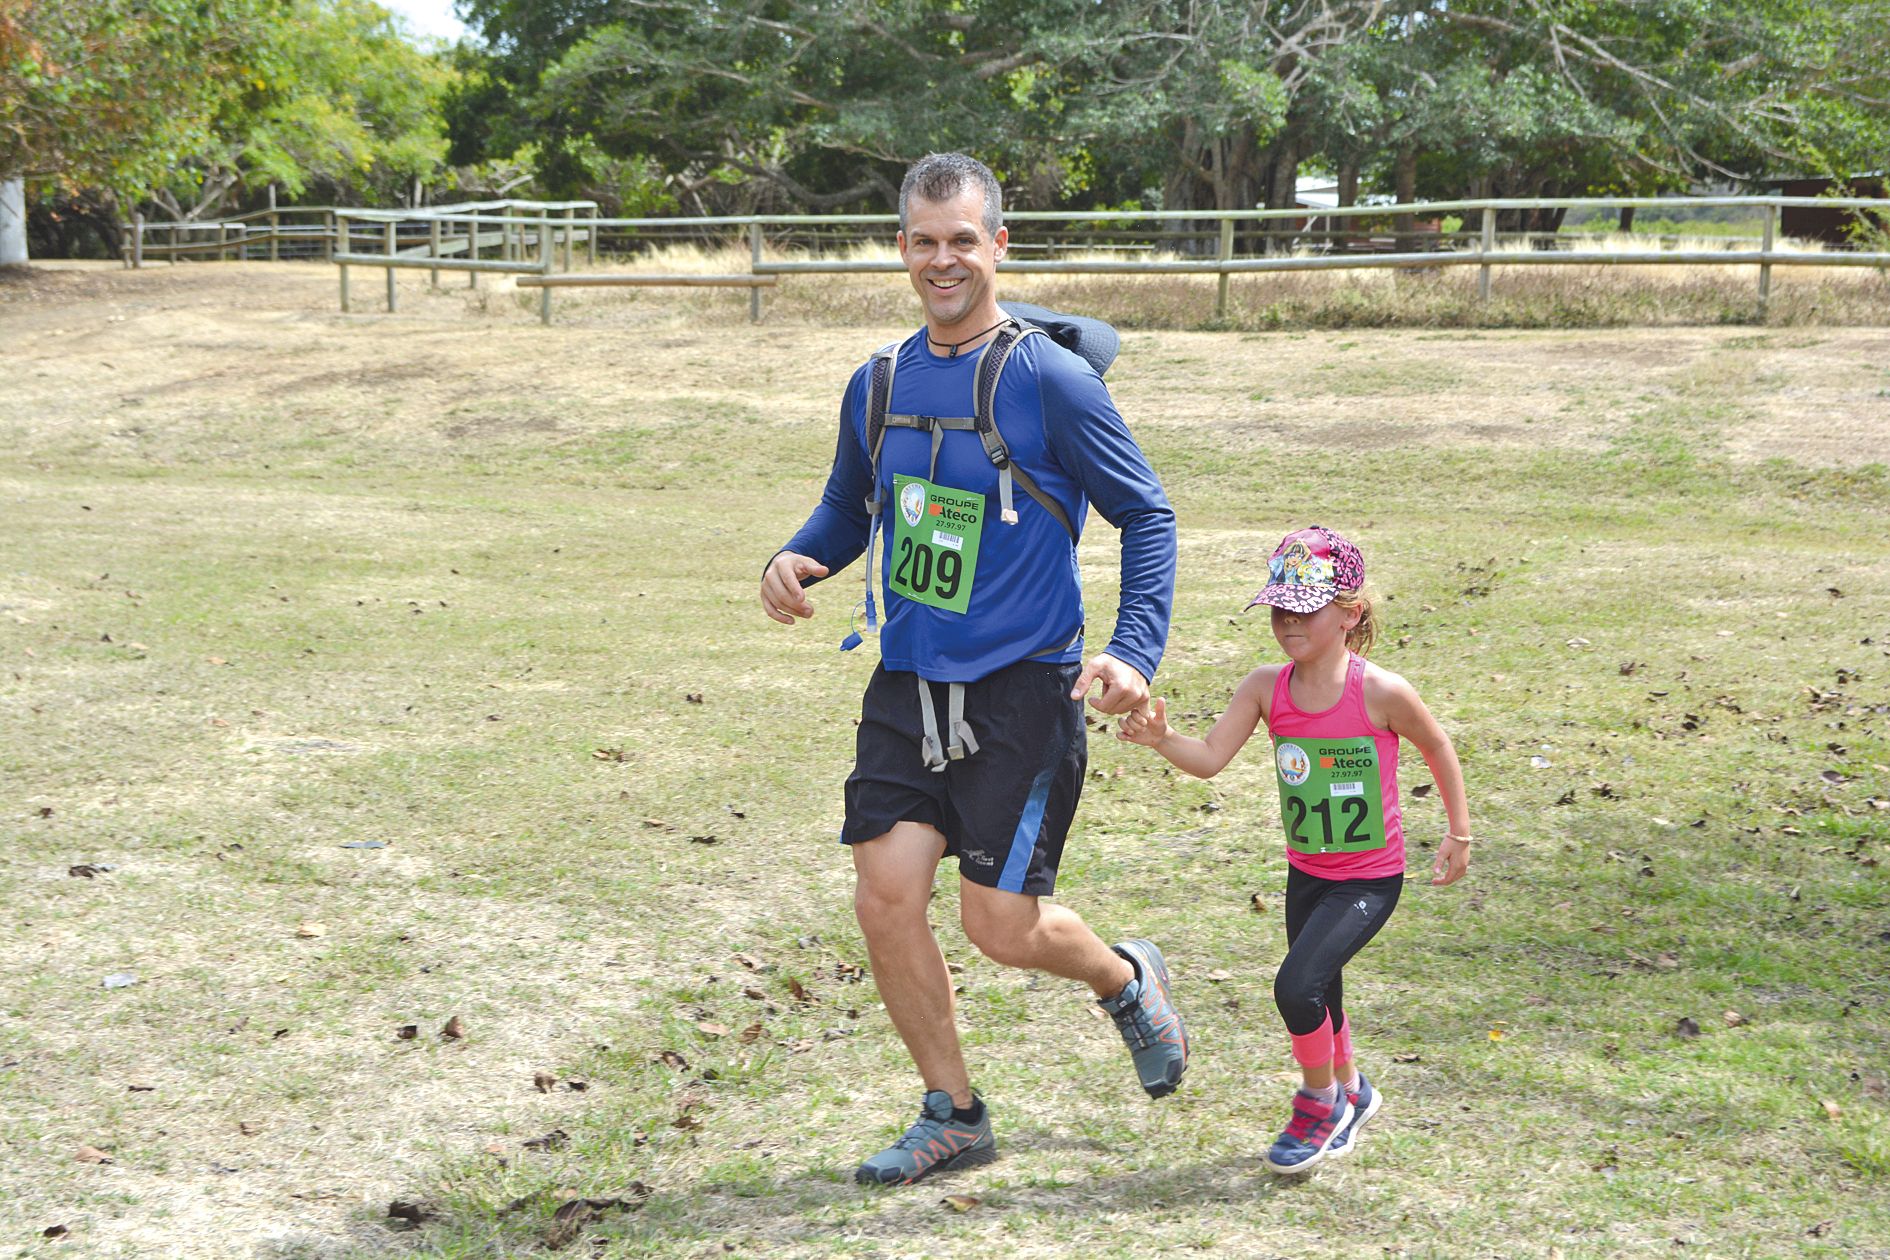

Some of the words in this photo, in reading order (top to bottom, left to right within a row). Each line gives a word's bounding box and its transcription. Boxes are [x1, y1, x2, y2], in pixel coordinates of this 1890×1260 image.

[930, 494, 979, 511] GROUPE
[935, 519, 966, 532] 27.97.97
[894, 536, 963, 600] 209
[1319, 746, 1372, 756] GROUPE
[1331, 770, 1363, 778] 27.97.97
[1286, 795, 1371, 844] 212
